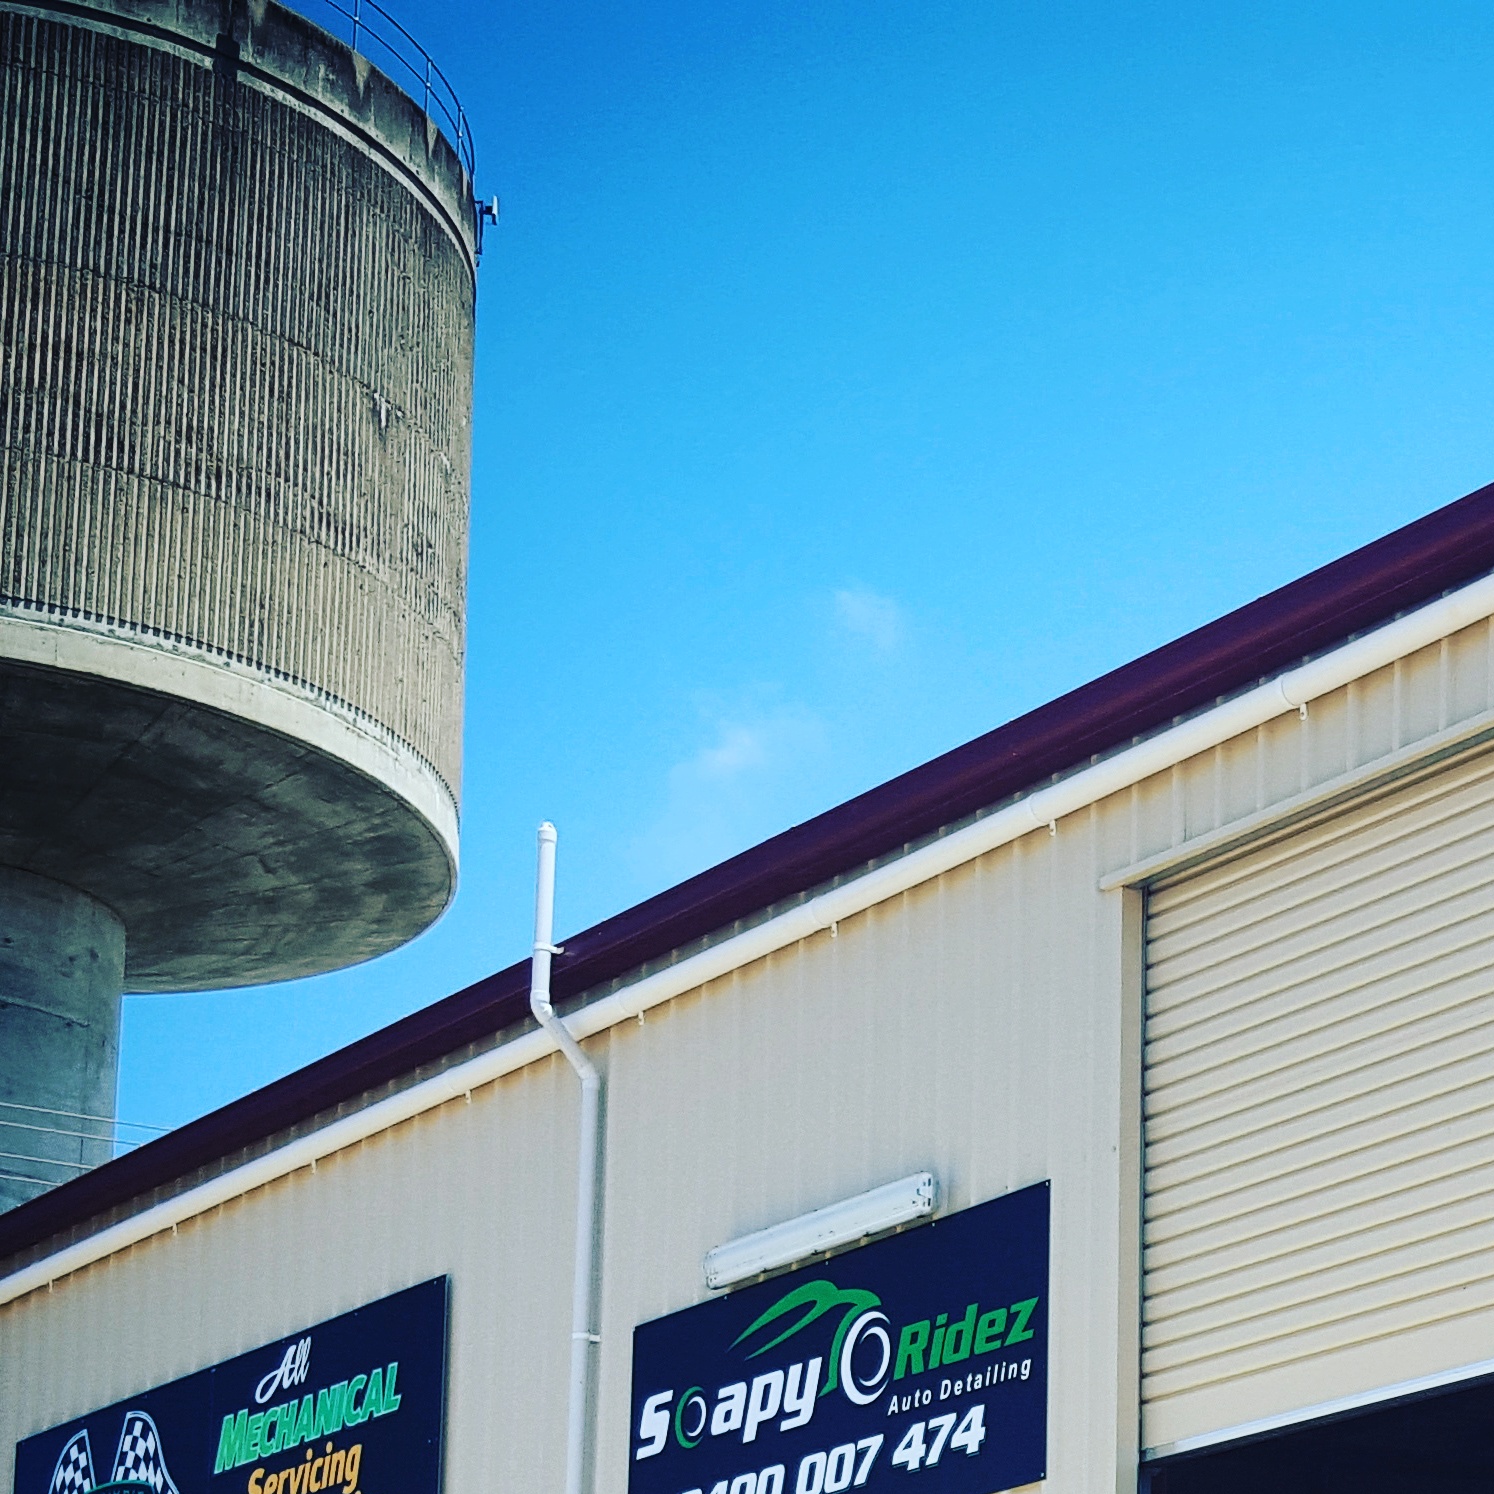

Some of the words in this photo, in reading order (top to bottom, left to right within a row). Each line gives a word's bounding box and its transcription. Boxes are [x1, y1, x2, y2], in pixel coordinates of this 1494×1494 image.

[255, 1337, 312, 1403] All
[893, 1296, 1039, 1380] Ridez
[214, 1362, 402, 1474] MECHANICAL
[636, 1356, 823, 1460] Soapy
[887, 1388, 931, 1416] Auto
[940, 1359, 1032, 1400] Detailing
[892, 1404, 985, 1471] 474
